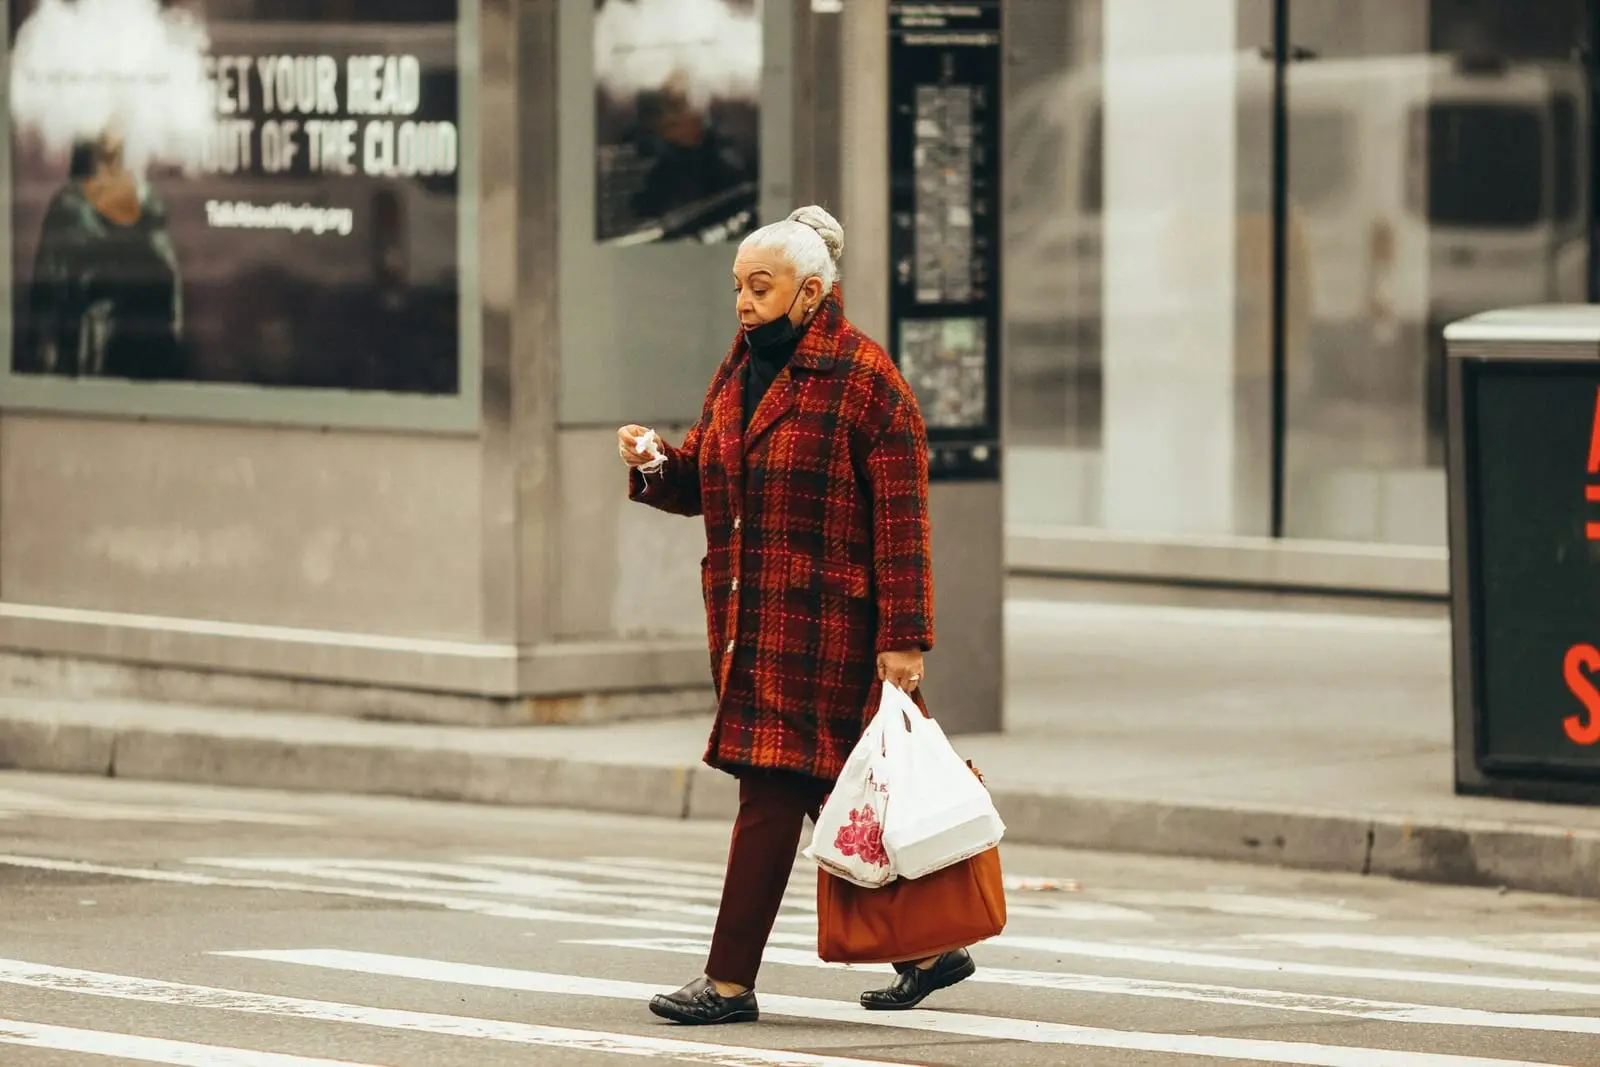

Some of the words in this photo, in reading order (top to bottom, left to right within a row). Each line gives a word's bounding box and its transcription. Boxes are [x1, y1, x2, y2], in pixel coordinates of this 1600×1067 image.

[257, 55, 338, 113] YOUR
[347, 55, 420, 115] HEAD
[261, 120, 299, 173] OF
[304, 120, 358, 175] THE
[363, 120, 457, 176] CLOUD
